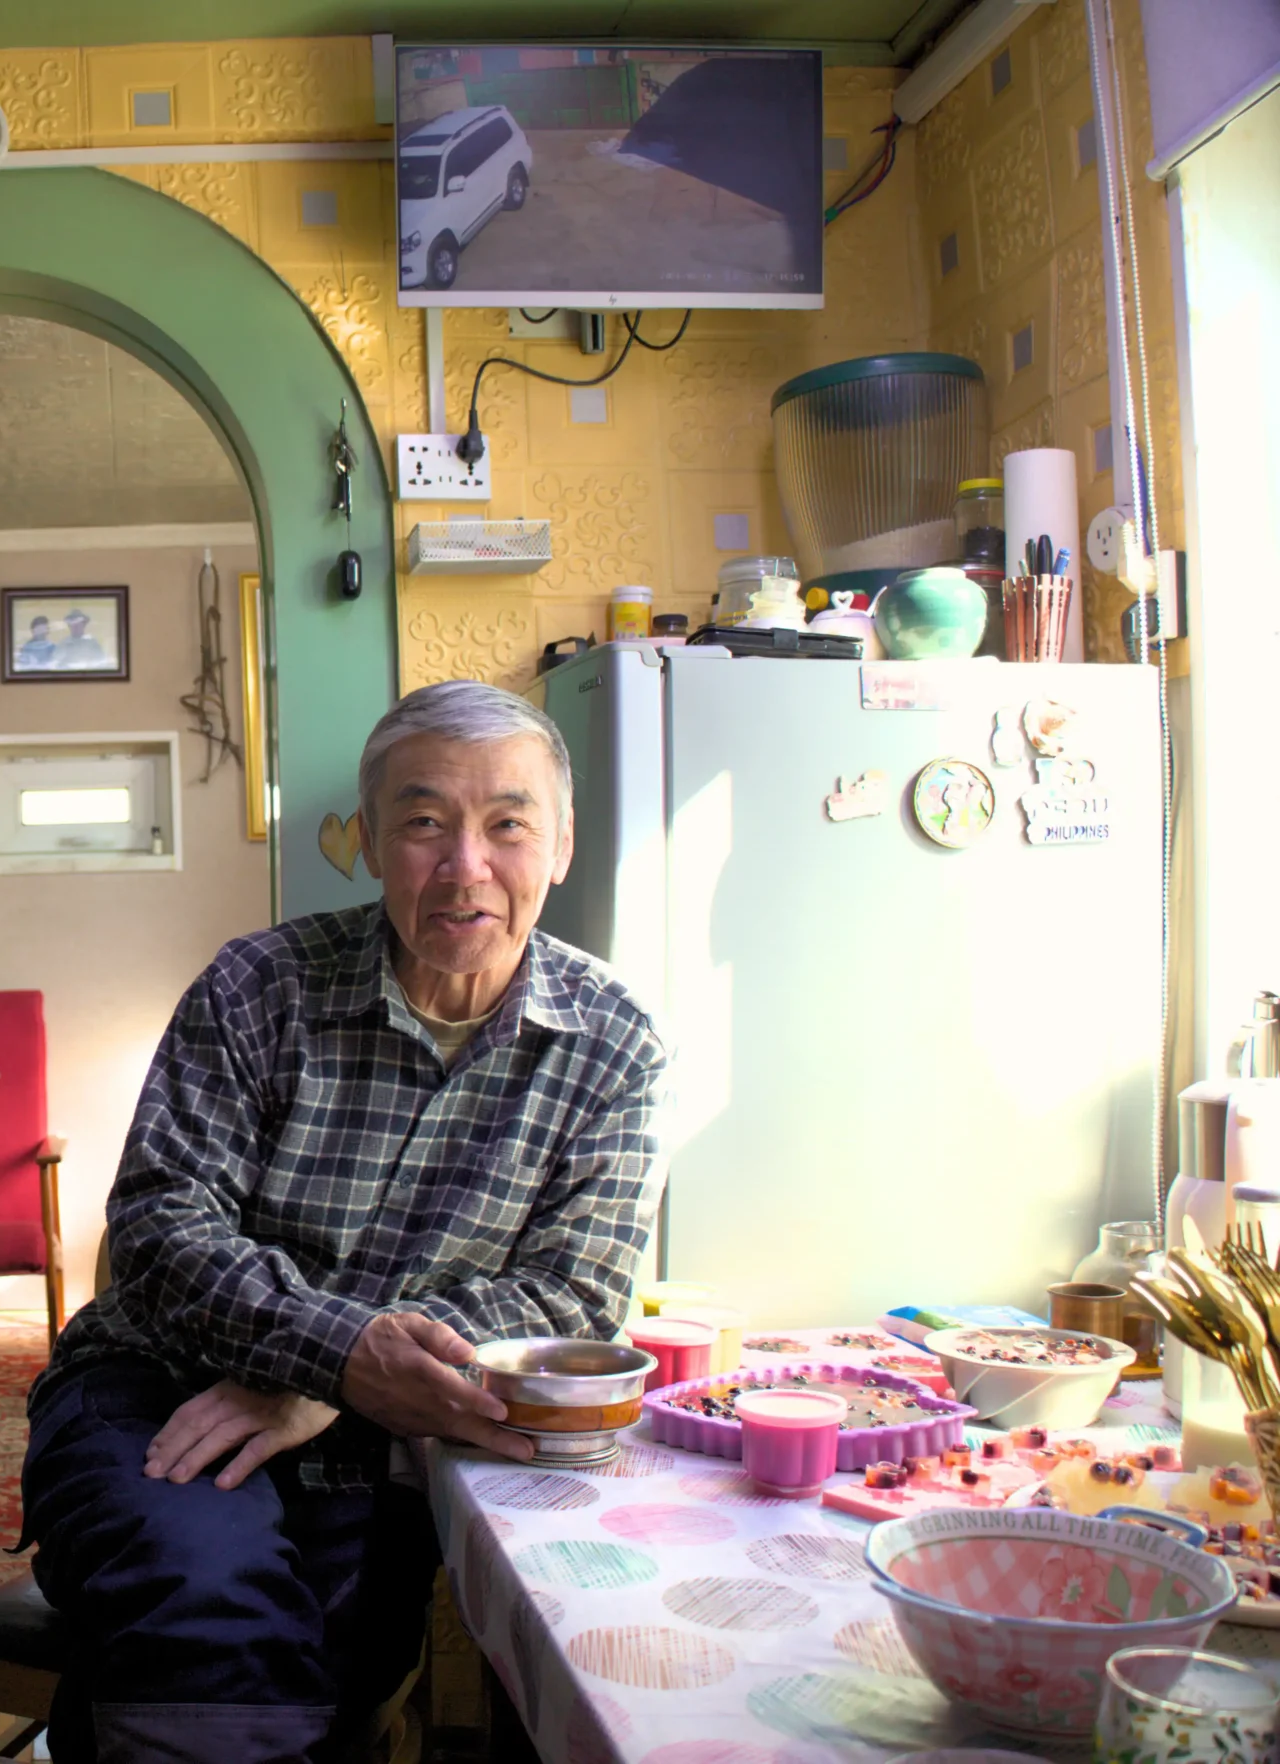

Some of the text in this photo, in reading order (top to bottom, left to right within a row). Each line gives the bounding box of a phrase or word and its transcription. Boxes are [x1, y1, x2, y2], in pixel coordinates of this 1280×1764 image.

[1044, 824, 1110, 842] PHILIPPINES
[920, 1510, 1017, 1535] GRINNING
[1021, 1513, 1061, 1532] ALL
[1064, 1517, 1108, 1540] THE
